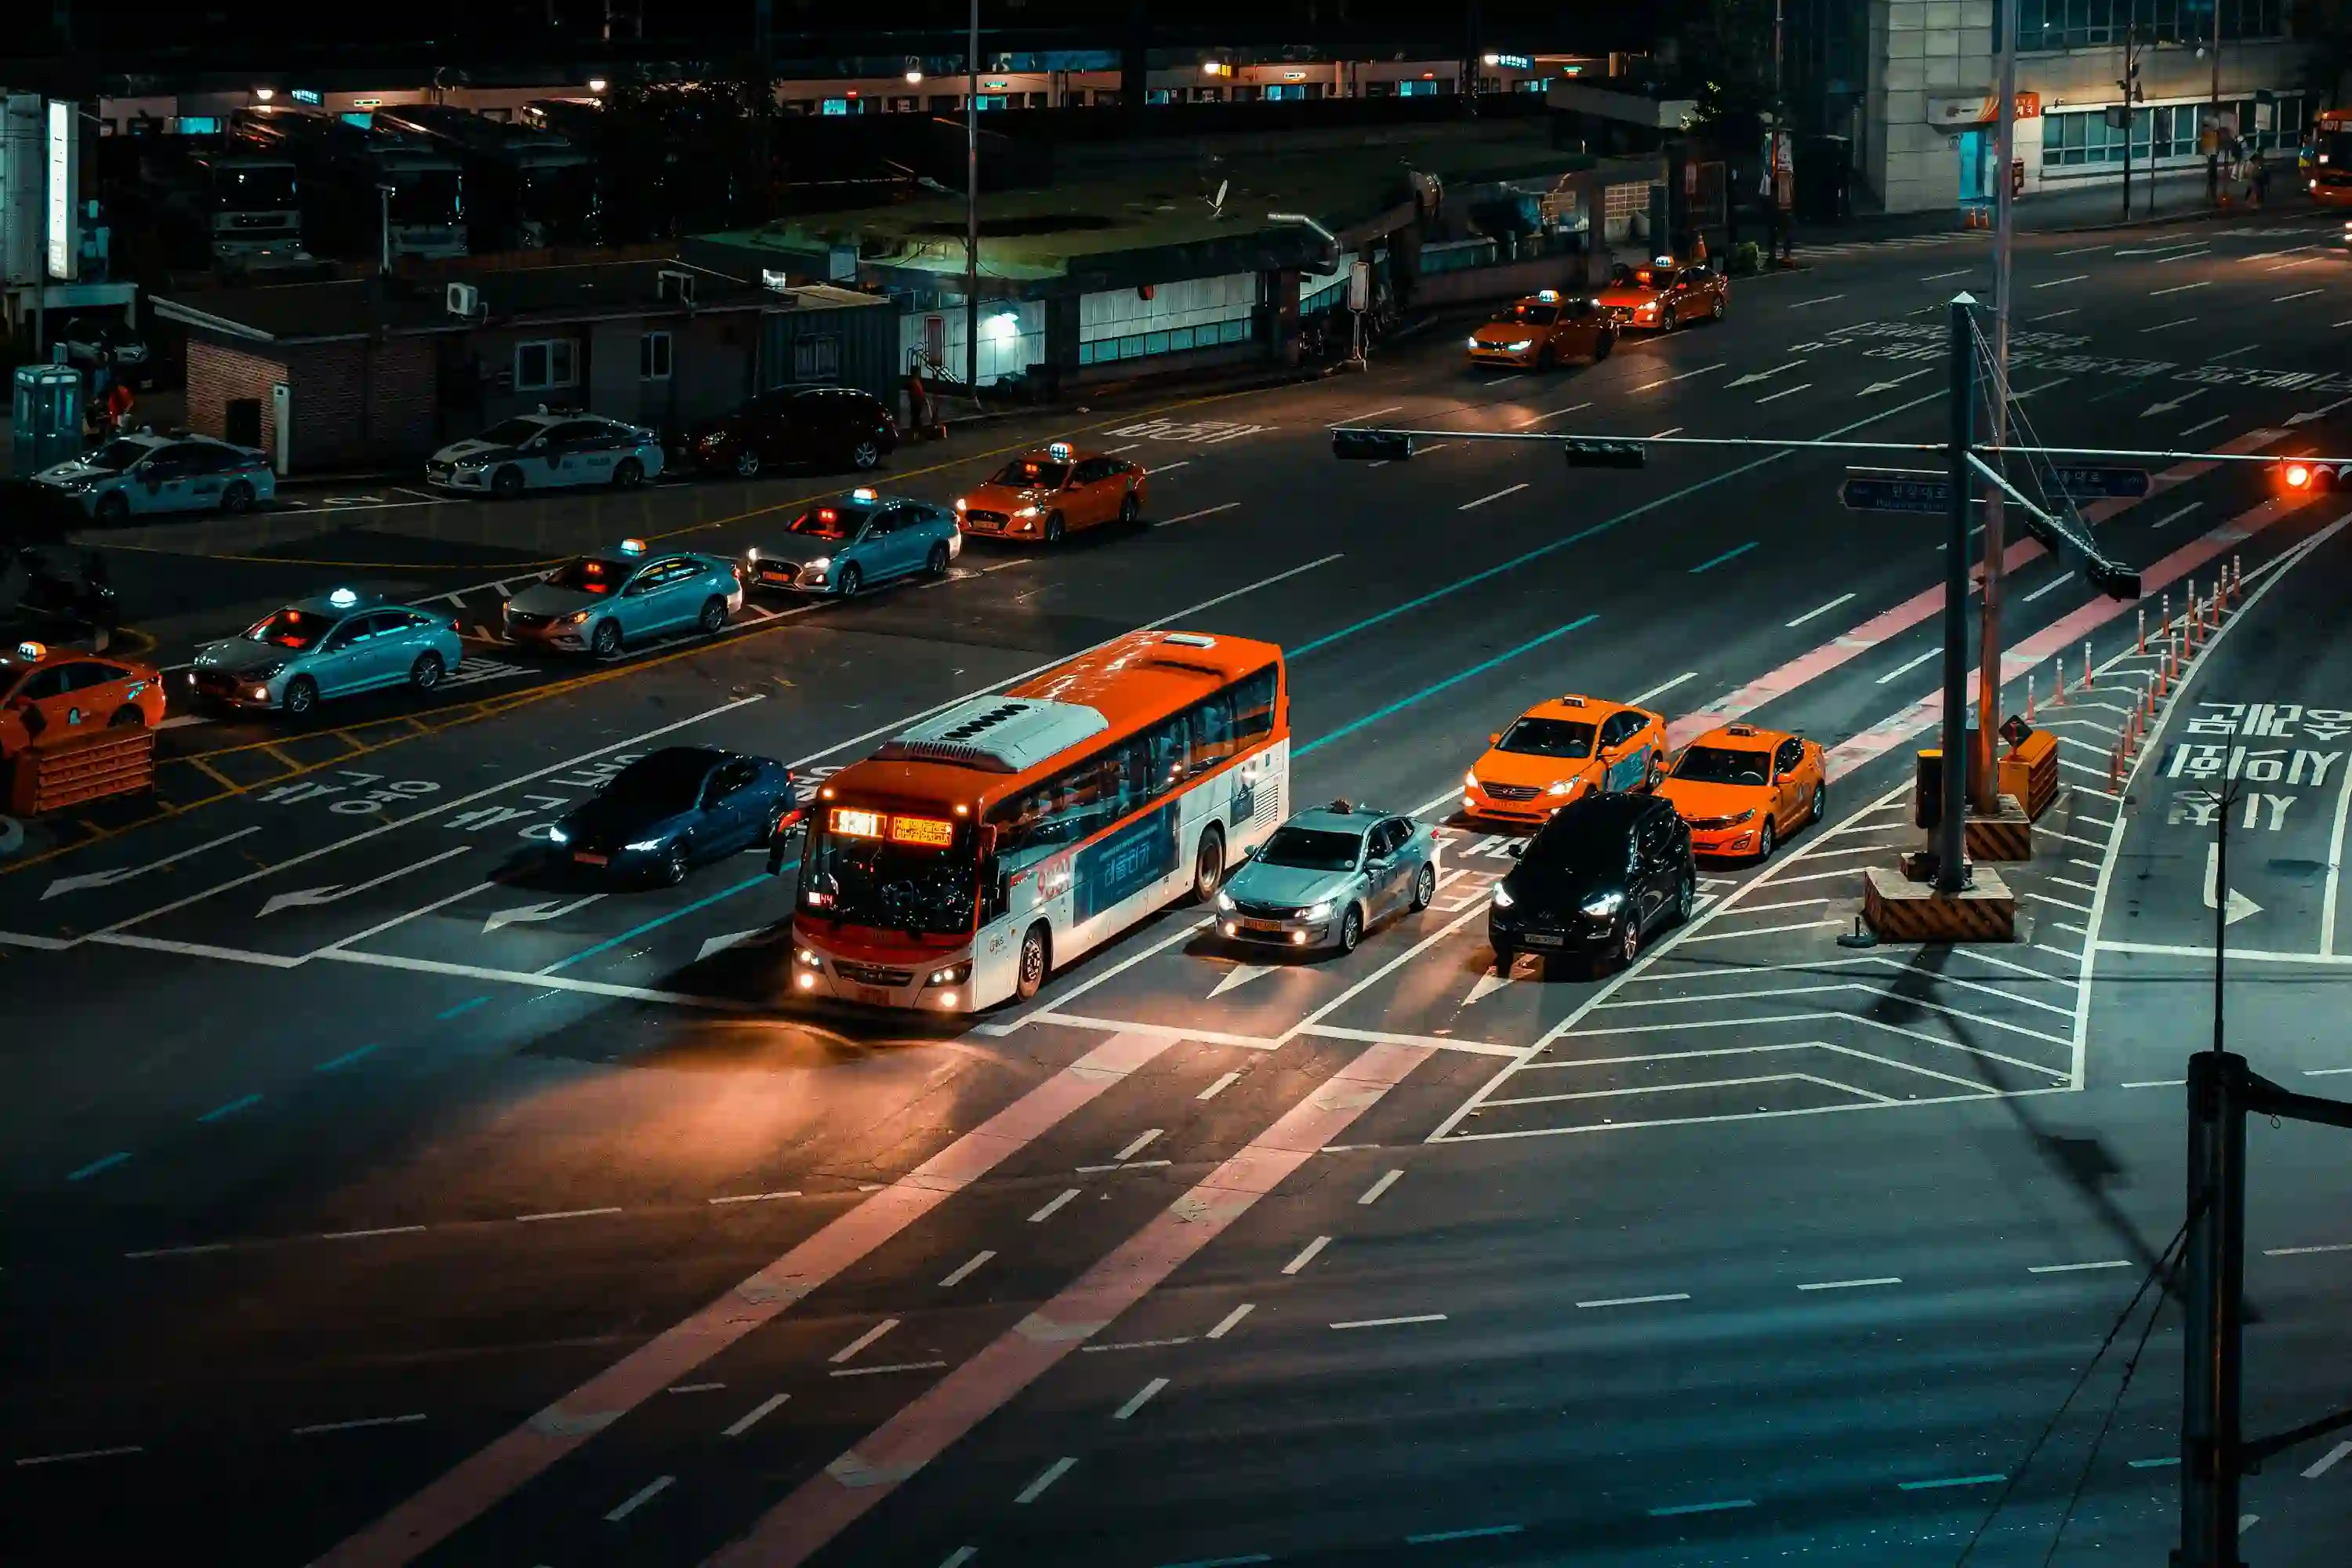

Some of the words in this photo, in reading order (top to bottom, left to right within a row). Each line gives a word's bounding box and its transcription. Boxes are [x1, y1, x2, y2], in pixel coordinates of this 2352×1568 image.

[2185, 702, 2352, 741] 숭례문
[2166, 743, 2343, 786] 시의회
[256, 770, 441, 815] 용산
